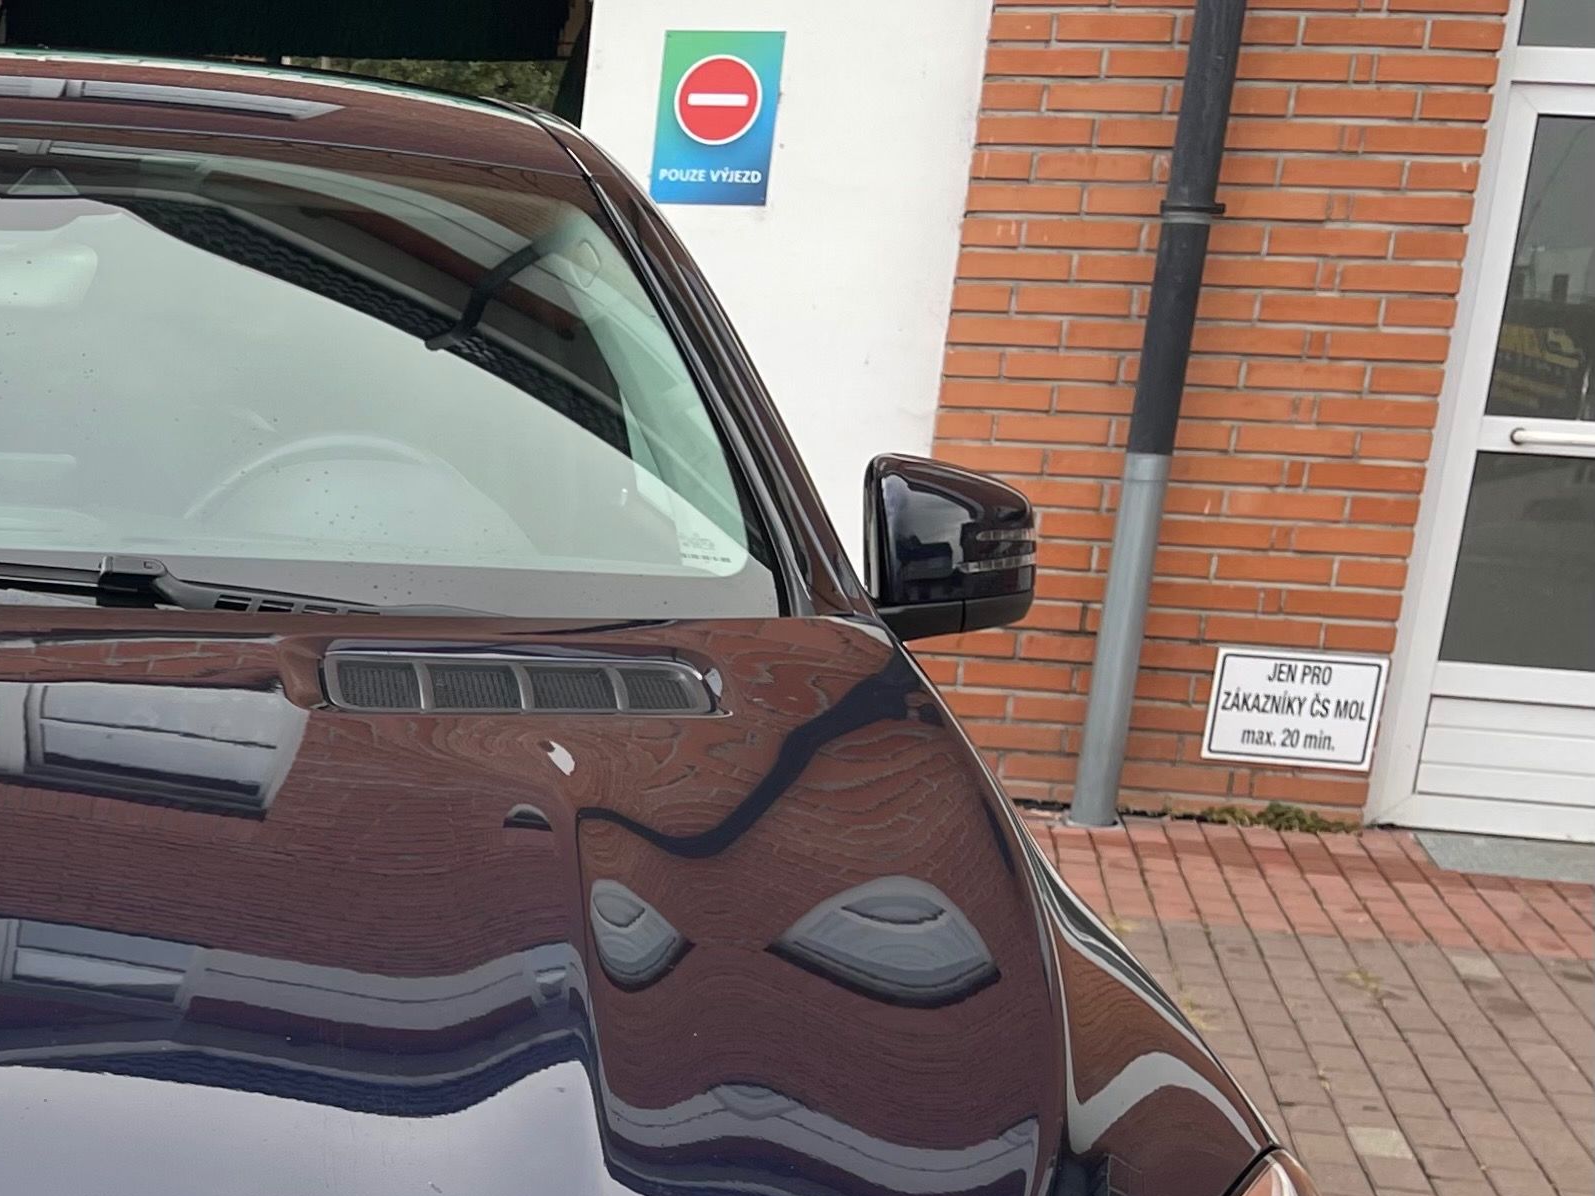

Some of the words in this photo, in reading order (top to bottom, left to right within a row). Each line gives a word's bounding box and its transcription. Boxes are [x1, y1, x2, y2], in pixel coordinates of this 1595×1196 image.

[659, 168, 707, 182] POUZE
[709, 166, 763, 184] VÝJEZD
[1267, 662, 1298, 684] JEN
[1300, 665, 1333, 686] PRO
[1221, 686, 1307, 718] ZÁKAZNÍKY
[1309, 693, 1330, 719] ČS
[1333, 699, 1367, 722] MOL
[1240, 728, 1277, 746] max.
[1280, 727, 1301, 749] 20
[1303, 729, 1336, 752] min.
